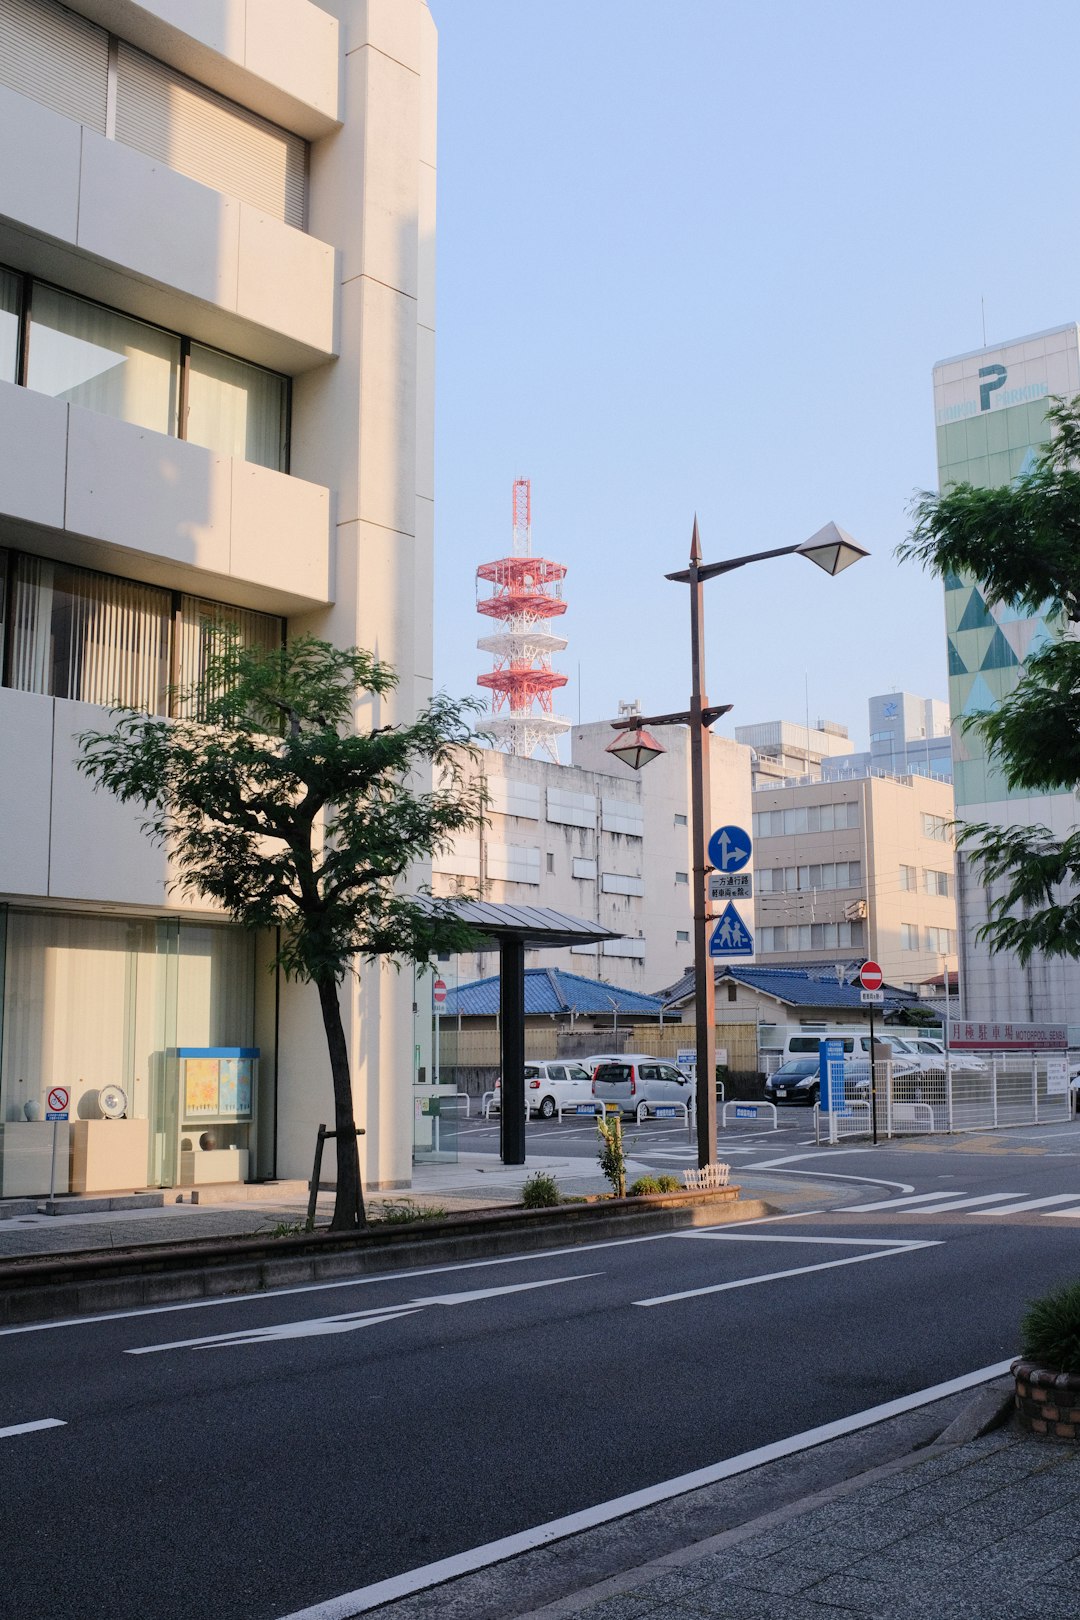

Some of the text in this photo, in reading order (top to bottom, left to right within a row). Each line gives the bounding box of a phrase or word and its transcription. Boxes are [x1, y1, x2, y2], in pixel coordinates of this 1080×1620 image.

[978, 364, 1007, 411] P
[712, 887, 749, 898] 軽車両を除く
[953, 1023, 1013, 1040] 月極駐車場
